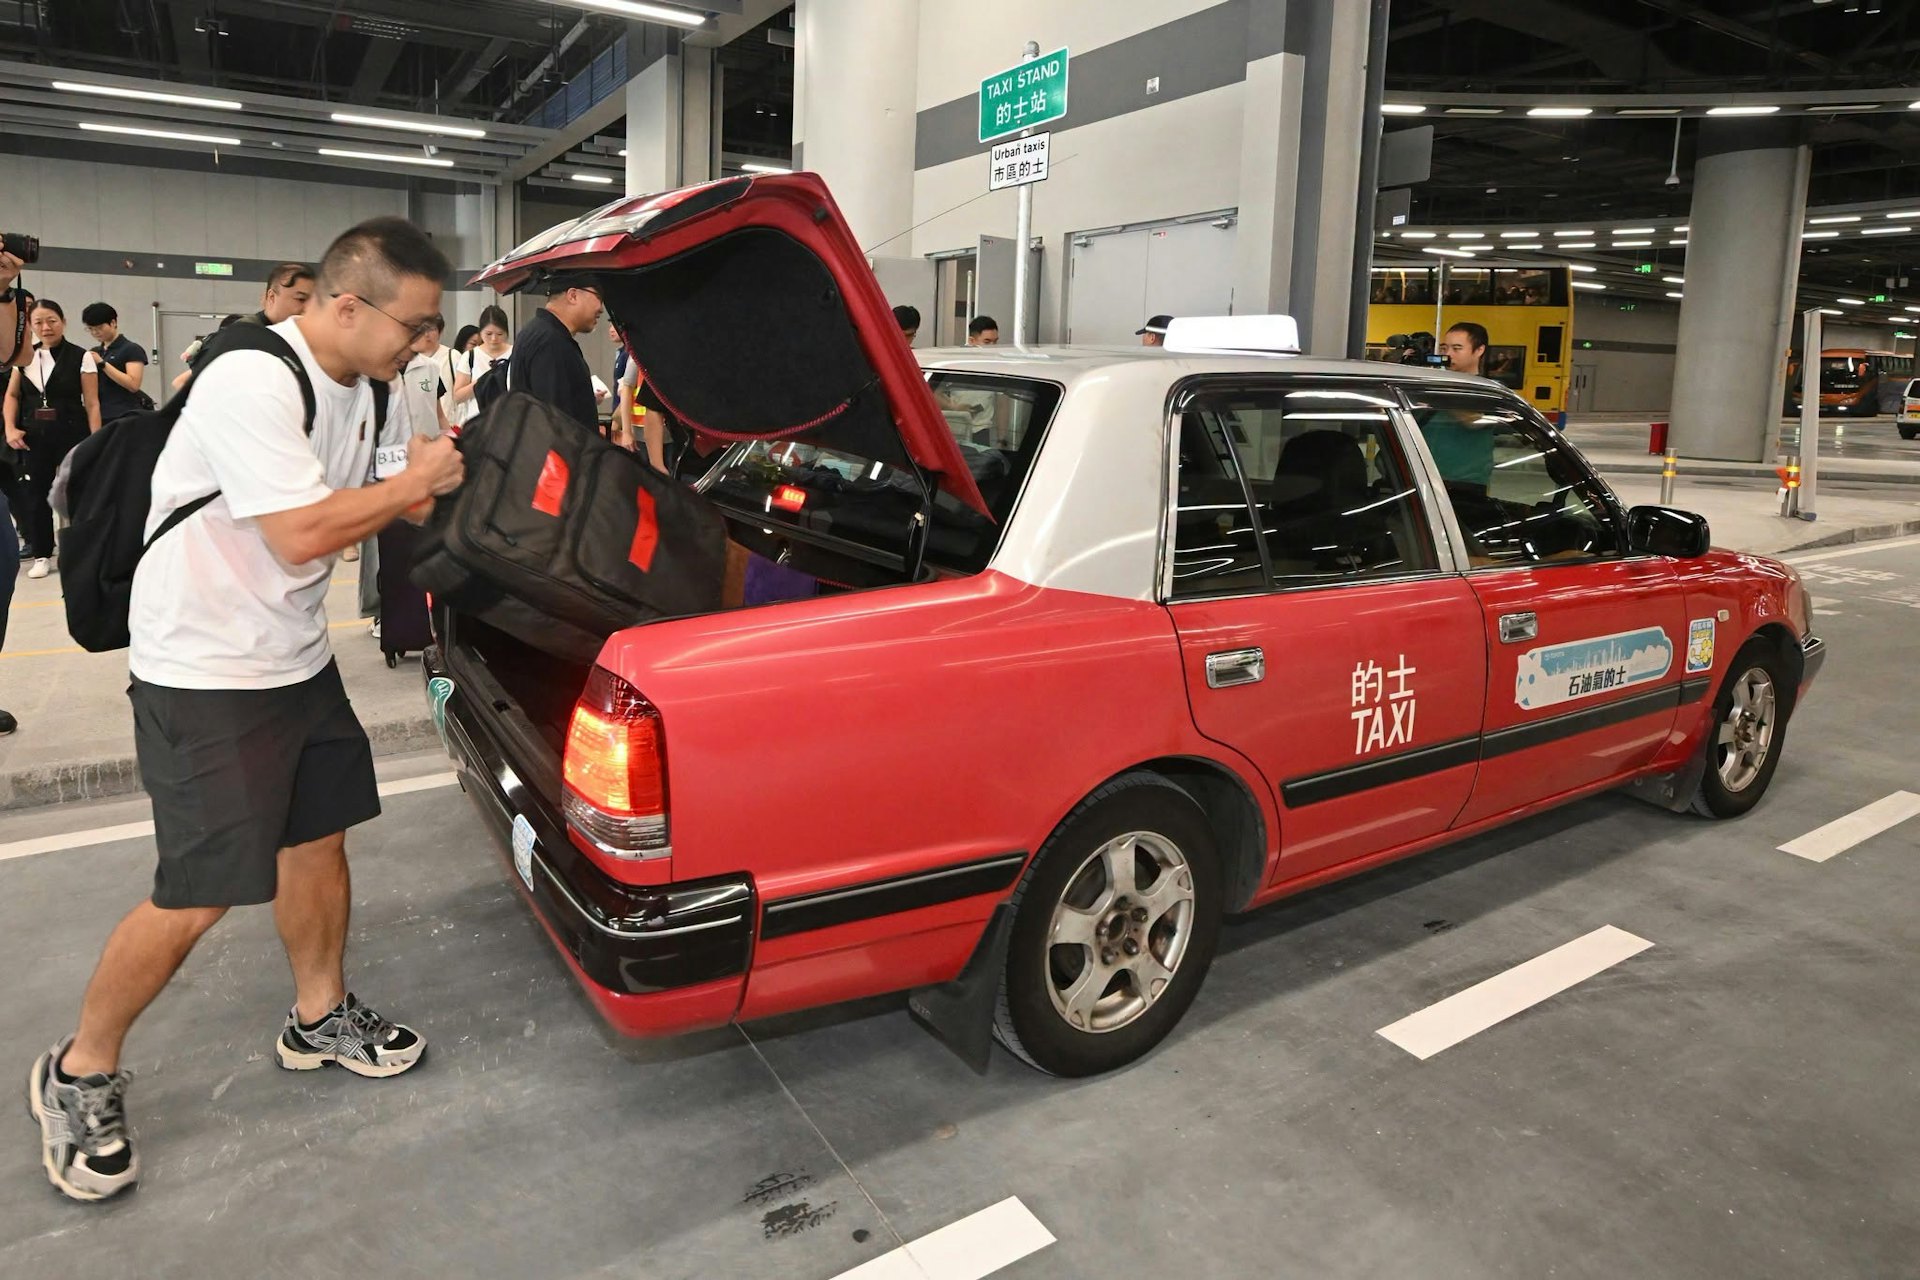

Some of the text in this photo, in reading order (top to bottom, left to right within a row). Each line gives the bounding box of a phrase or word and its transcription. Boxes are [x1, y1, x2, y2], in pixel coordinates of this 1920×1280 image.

[987, 60, 1060, 99] TAXI STAND
[995, 89, 1047, 126] 的士站
[994, 140, 1045, 161] Urban taxis
[994, 157, 1044, 183] 市區的士
[1351, 654, 1416, 707] 的士
[1568, 665, 1627, 697] 石油氣的士
[1351, 699, 1416, 755] TAXI
